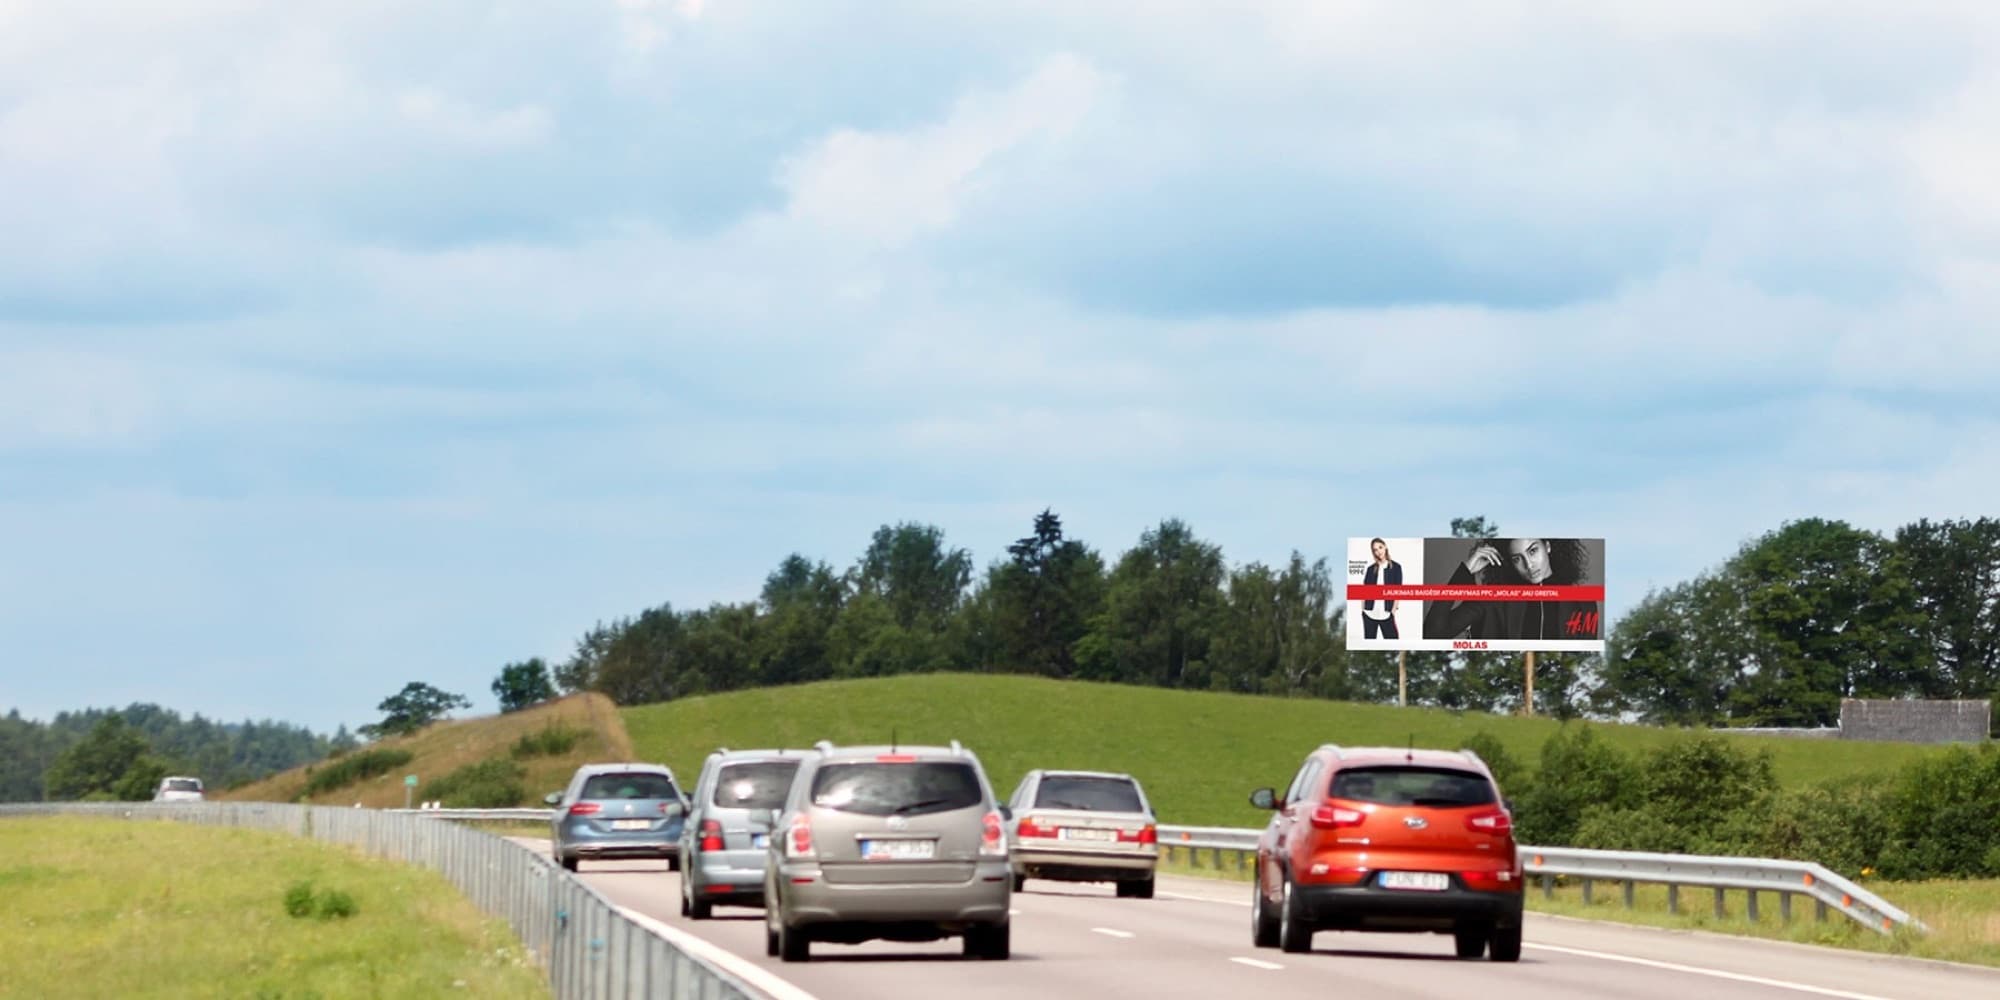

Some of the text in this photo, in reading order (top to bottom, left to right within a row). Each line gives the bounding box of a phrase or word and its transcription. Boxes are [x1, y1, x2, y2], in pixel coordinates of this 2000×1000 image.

[1382, 589, 1414, 597] LAUKIMAS
[1441, 589, 1481, 597] ATIDARYMAS
[1522, 589, 1535, 597] JAU
[1453, 641, 1488, 650] MOLAS
